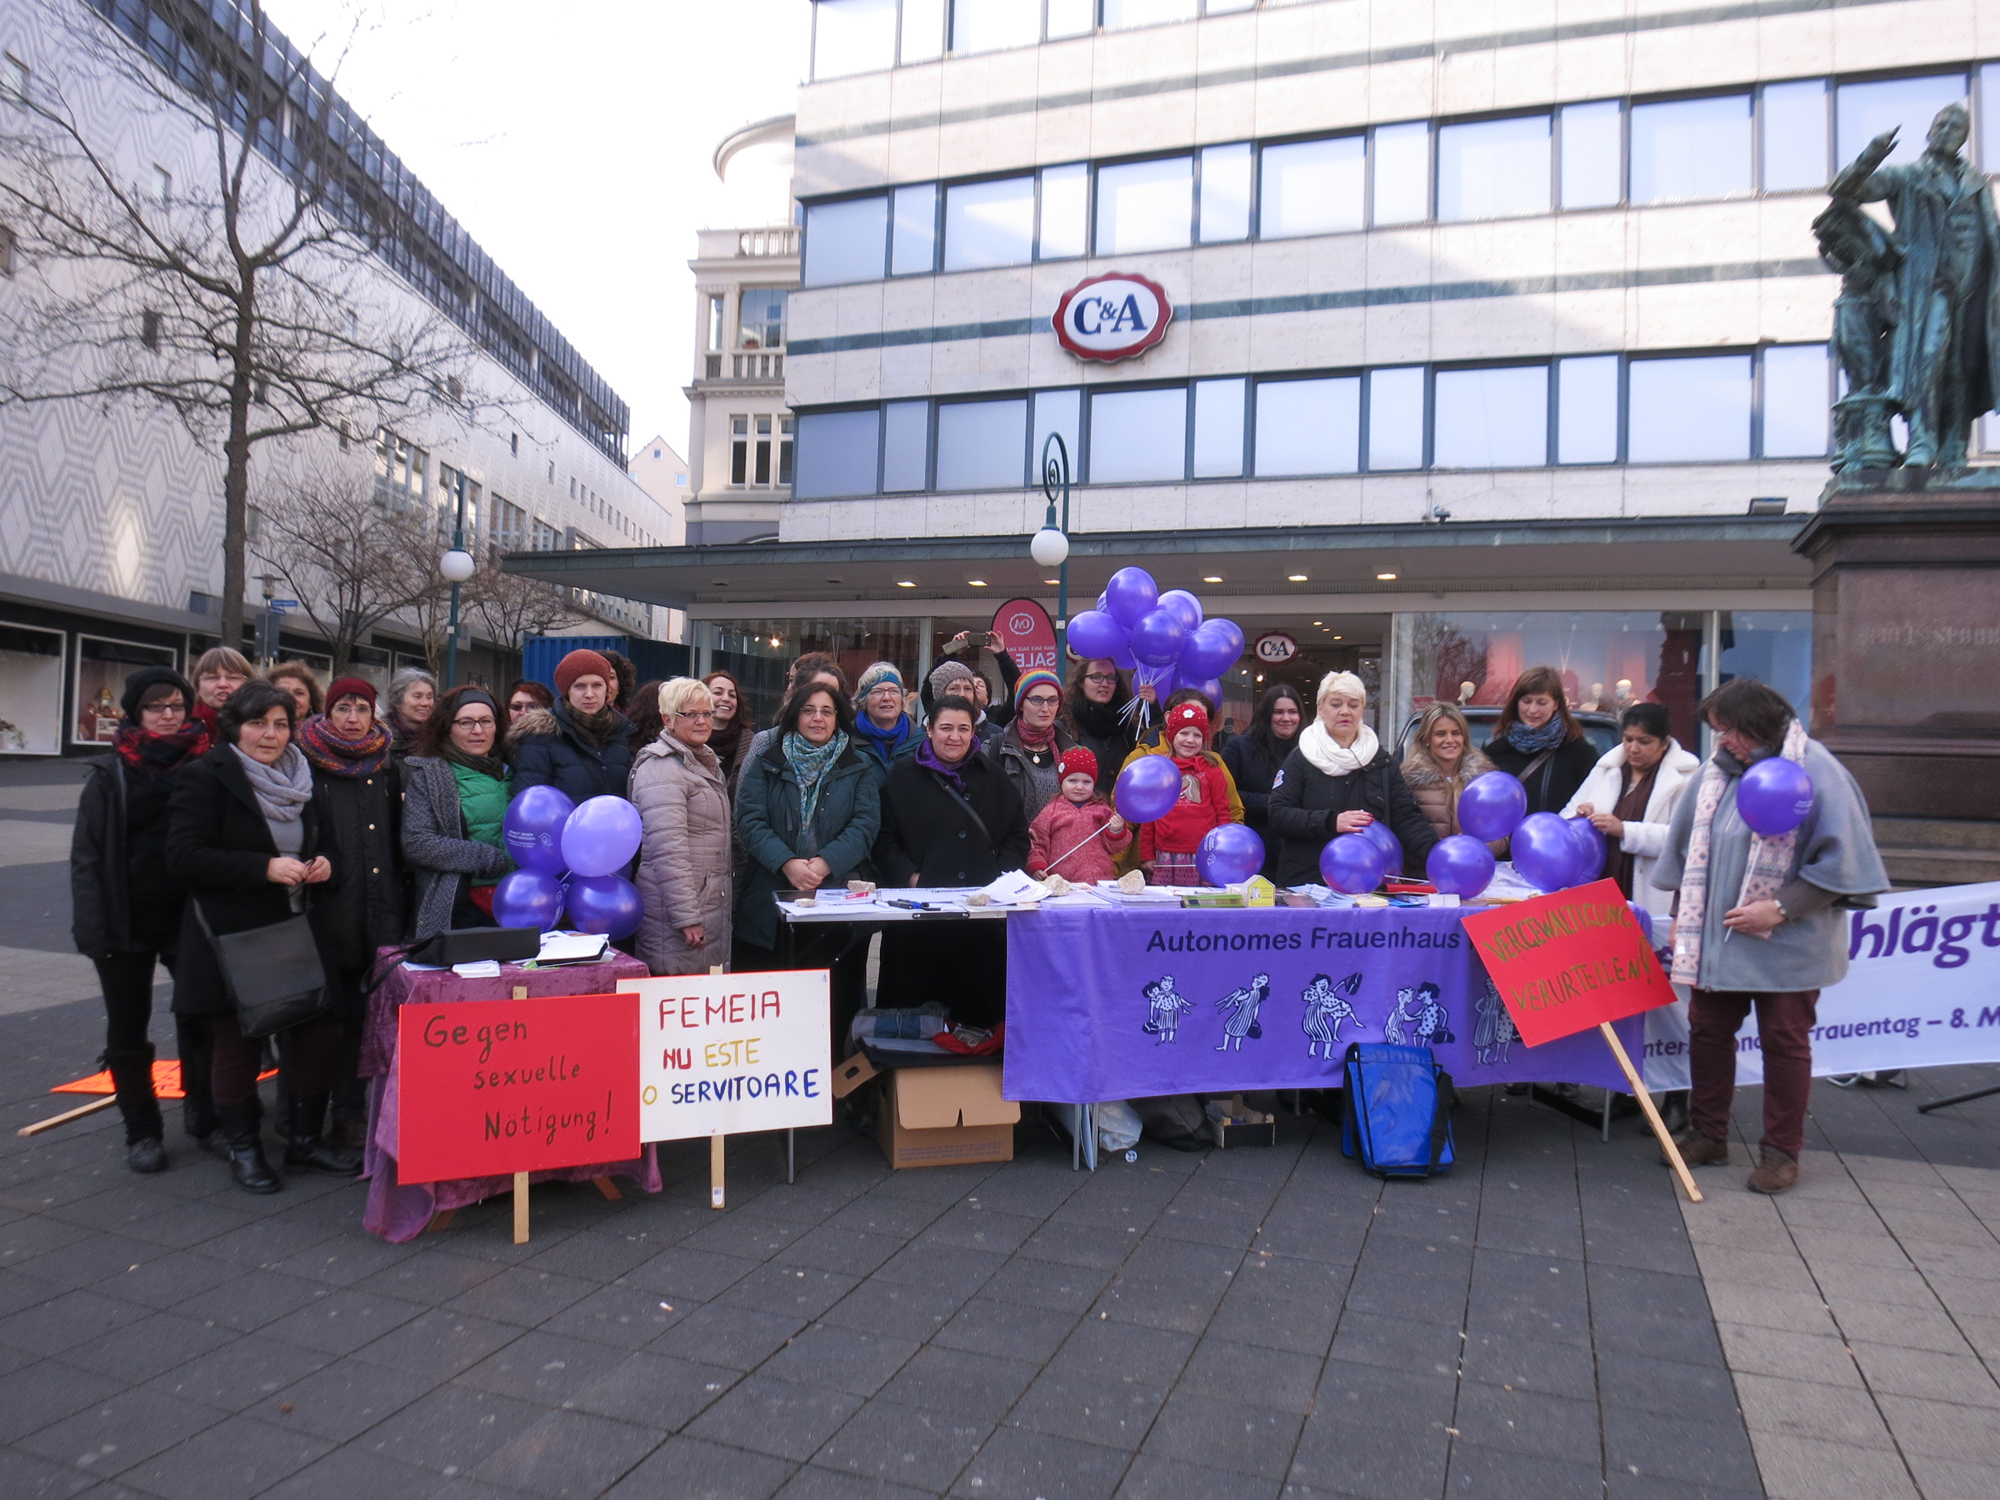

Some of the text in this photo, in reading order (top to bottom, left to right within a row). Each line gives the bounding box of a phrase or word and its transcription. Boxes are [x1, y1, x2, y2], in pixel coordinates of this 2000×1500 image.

[1073, 293, 1148, 335] C&A
[1260, 640, 1290, 657] C&A
[1146, 929, 1302, 953] Autonomes
[1310, 926, 1460, 950] Frauenhaus
[1849, 904, 2000, 969] hlägt
[659, 991, 781, 1031] FEMEIA
[1808, 1016, 1921, 1042] rauentag
[1949, 1007, 1970, 1029] 8.
[423, 1015, 528, 1064] Gegen
[663, 1037, 762, 1070] NU ESTE
[473, 1054, 581, 1090] sexuelle
[642, 1068, 821, 1106] O SERVITOARE
[484, 1089, 612, 1145] Nötigung!
